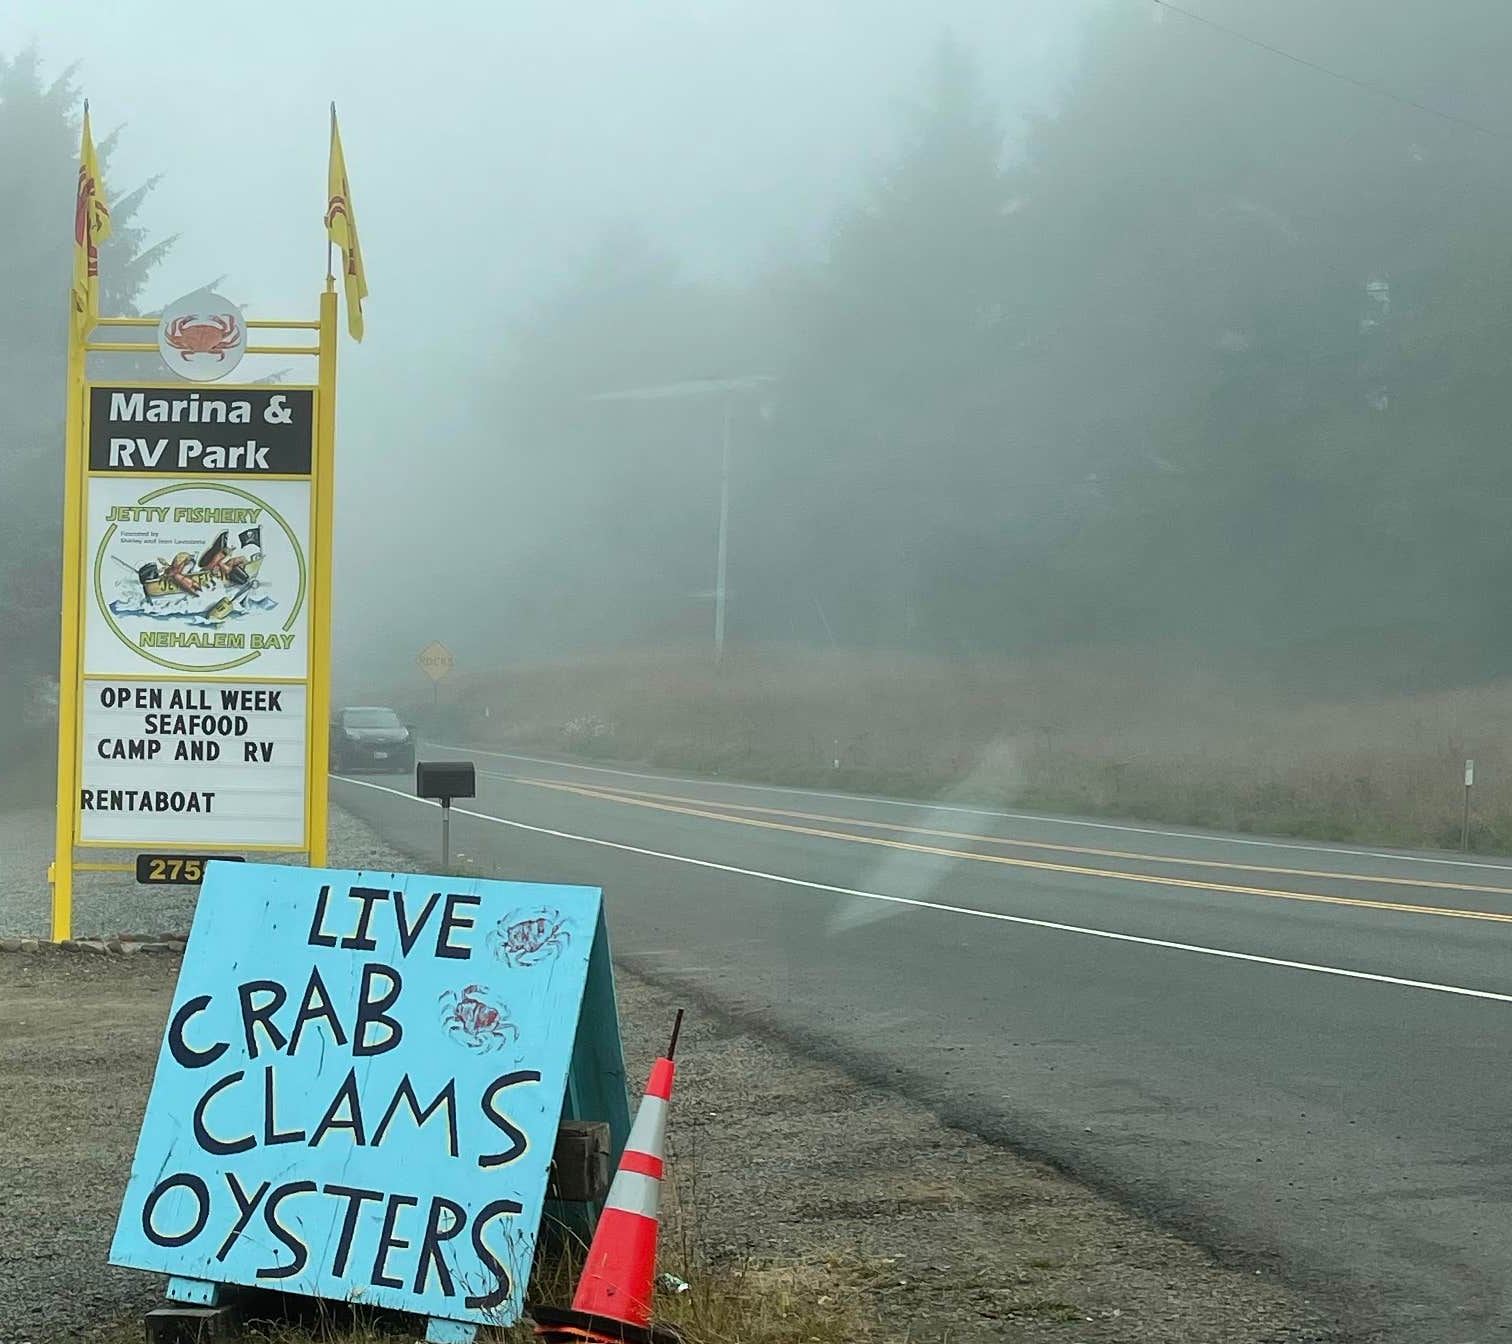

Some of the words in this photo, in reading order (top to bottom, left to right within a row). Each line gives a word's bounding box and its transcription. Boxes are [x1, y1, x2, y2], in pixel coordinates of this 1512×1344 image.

[109, 392, 251, 423] Marina
[263, 394, 293, 424] &
[108, 438, 168, 467] RV
[178, 439, 270, 469] Park
[106, 506, 170, 523] JETTY
[174, 507, 262, 524] FISHERY
[139, 632, 245, 649] NEHALEM
[250, 633, 295, 650] BAY
[100, 687, 162, 709] OPEN
[169, 689, 212, 710] ALL
[221, 690, 282, 711] WEEK
[144, 714, 248, 736] SEAFOOD
[97, 738, 161, 760] CAMP
[174, 740, 220, 761] AND
[244, 742, 274, 762] RV
[149, 858, 206, 881] 275
[308, 884, 481, 960] LIVE
[168, 963, 403, 1069] CRAB
[193, 1066, 541, 1168] CLAMS
[142, 1172, 523, 1309] OYSTERS
